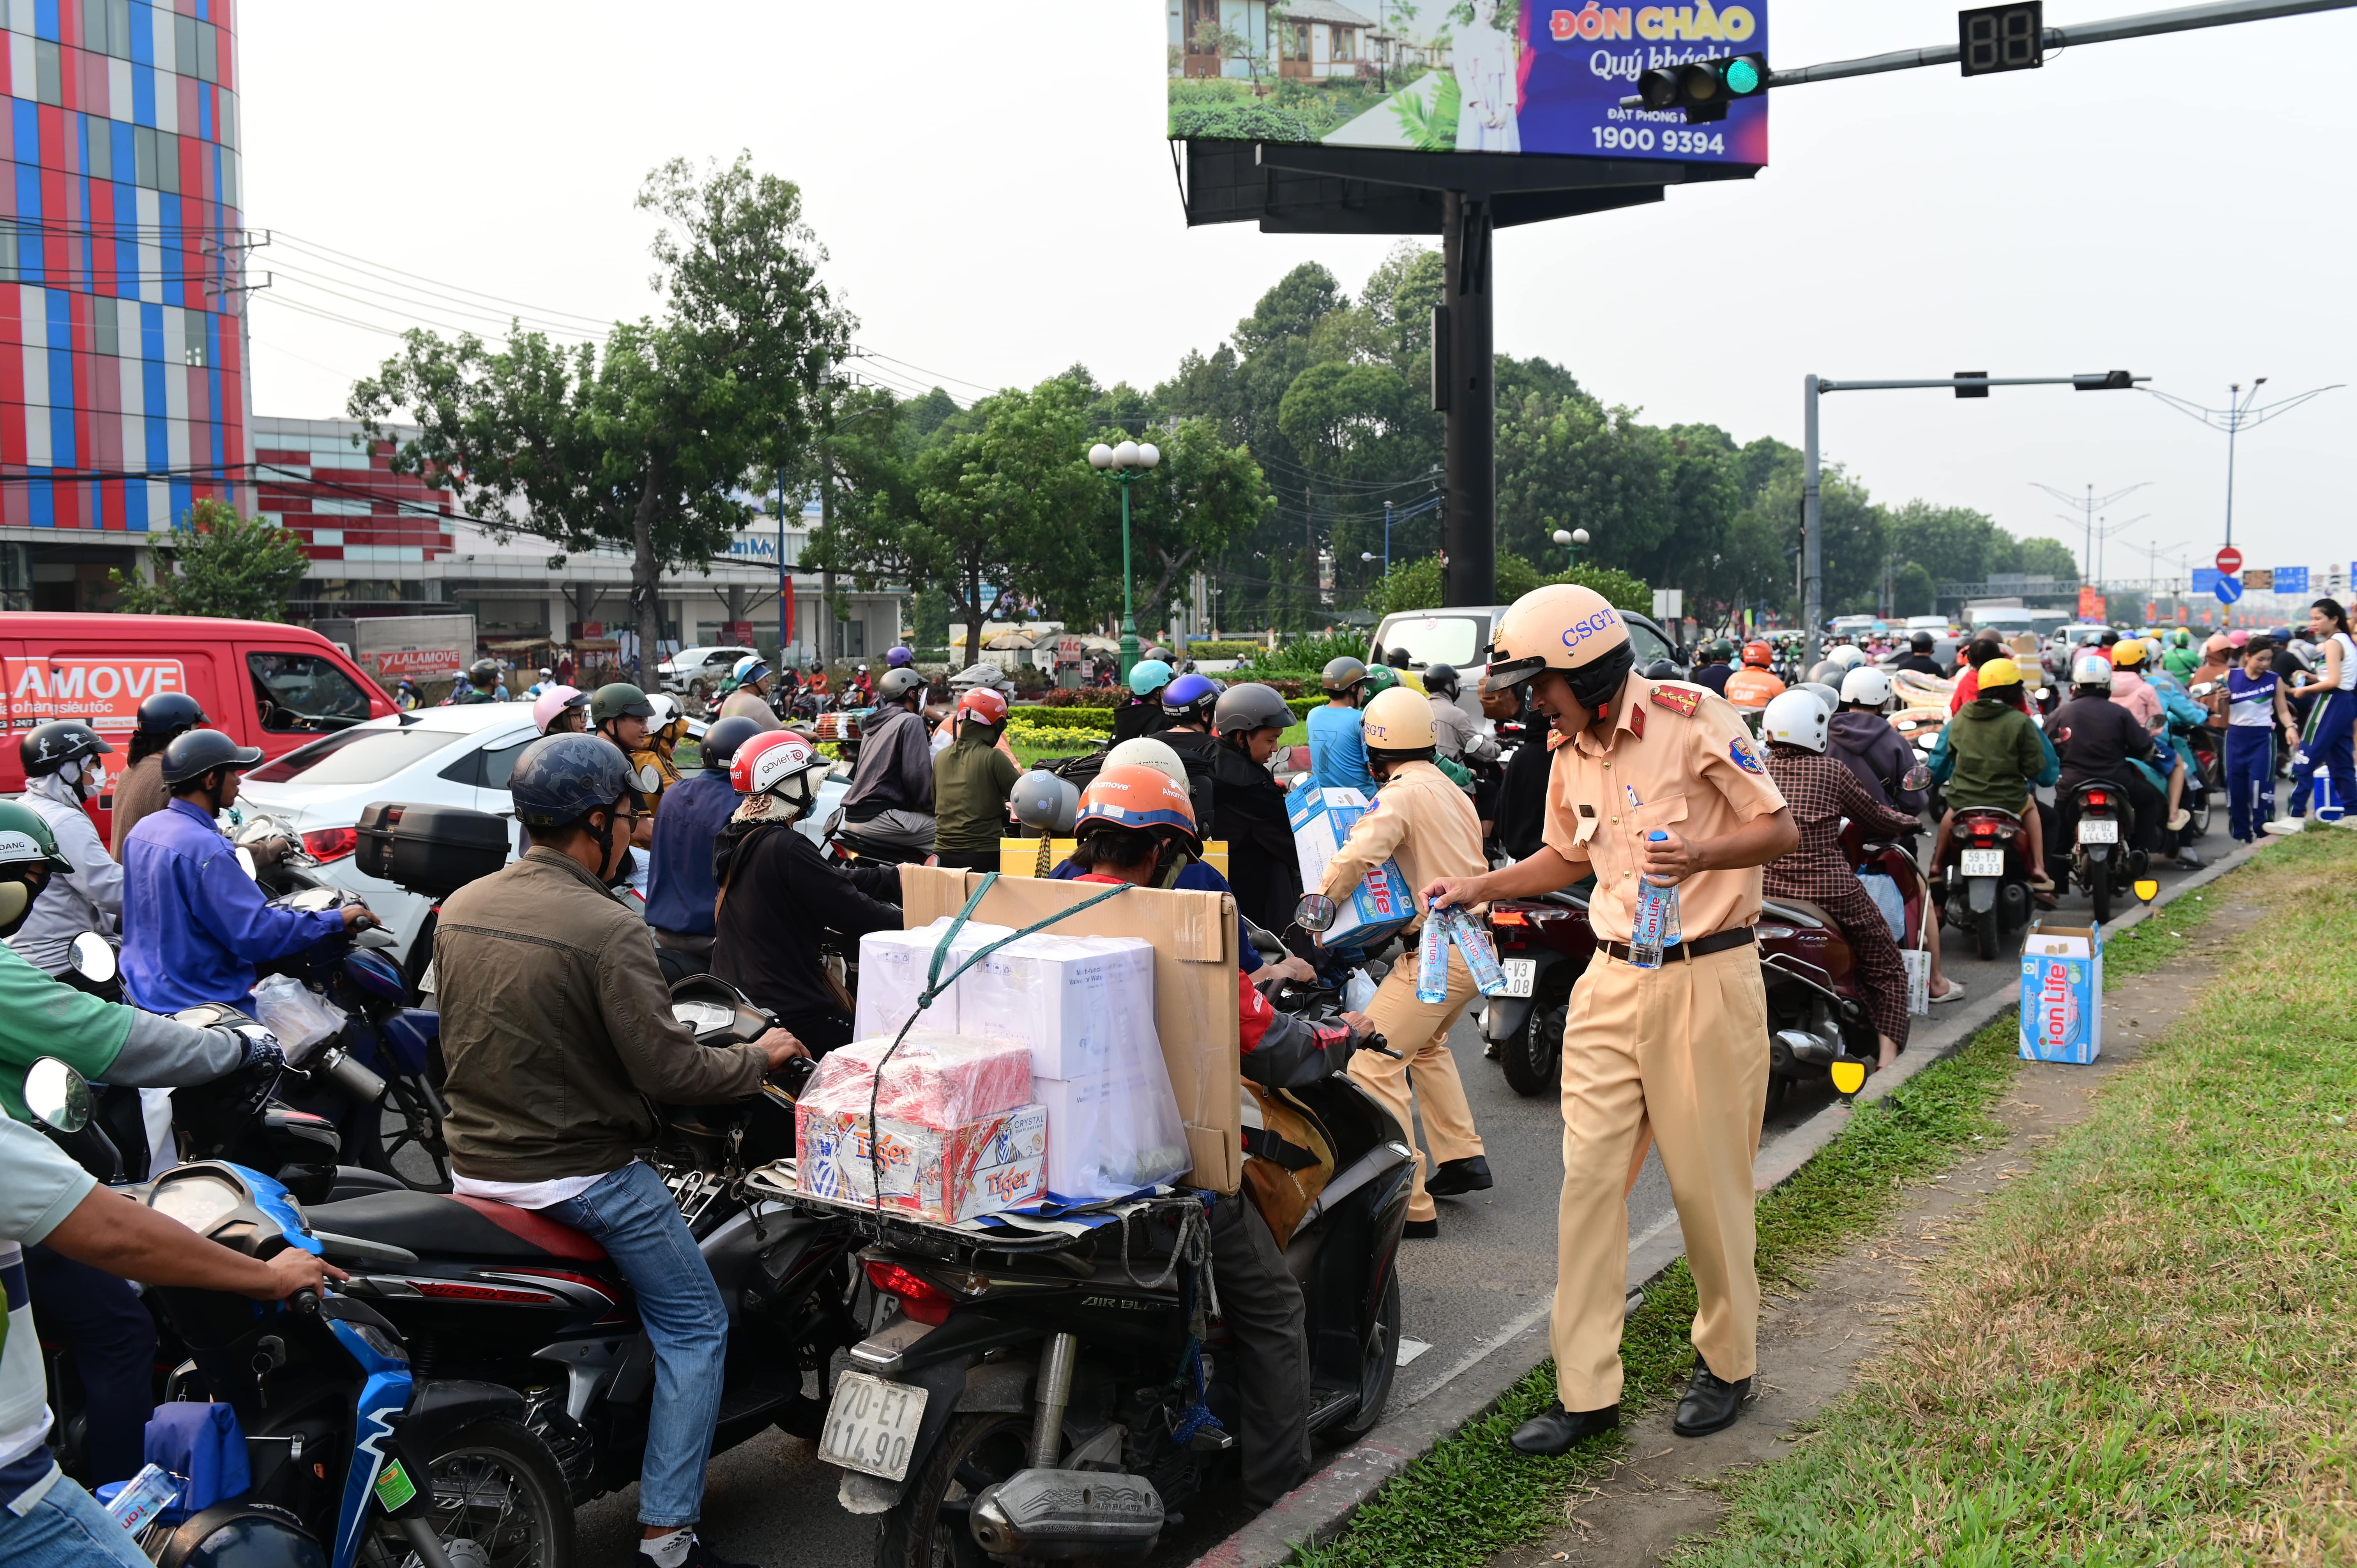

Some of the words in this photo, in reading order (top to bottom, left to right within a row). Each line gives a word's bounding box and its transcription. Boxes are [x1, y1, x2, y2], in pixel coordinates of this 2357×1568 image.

[1550, 1, 1632, 41] ĐÓN
[1635, 0, 1755, 41] CHÀO
[1590, 48, 1643, 82] Quý
[1592, 127, 1655, 151] 1900
[1662, 131, 1725, 155] 9394
[1562, 608, 1616, 647] CSGT
[394, 651, 459, 664] LALAMOVE
[59, 702, 90, 713] siêu
[90, 699, 113, 713] tốc
[1091, 782, 1129, 791] Ahamove
[2085, 823, 2111, 832] 59-U2
[2083, 833, 2115, 841] 444.55
[1968, 853, 1997, 862] 59-Y3
[1964, 864, 2000, 874] 048.33
[1367, 870, 1391, 914] Life
[1648, 896, 1661, 916] Life
[1428, 932, 1437, 948] Life
[1461, 929, 1473, 946] Life
[2044, 964, 2067, 1003] Life
[1014, 1114, 1044, 1129] CRYSTAL
[984, 1165, 1031, 1203] Tiger
[1291, 1173, 1307, 1201] Ahamove
[425, 1287, 467, 1295] AIR
[472, 1291, 550, 1302] BLADE
[1081, 1296, 1116, 1308] AIR
[843, 1383, 909, 1429] 70-E1
[829, 1418, 906, 1471] 114.90
